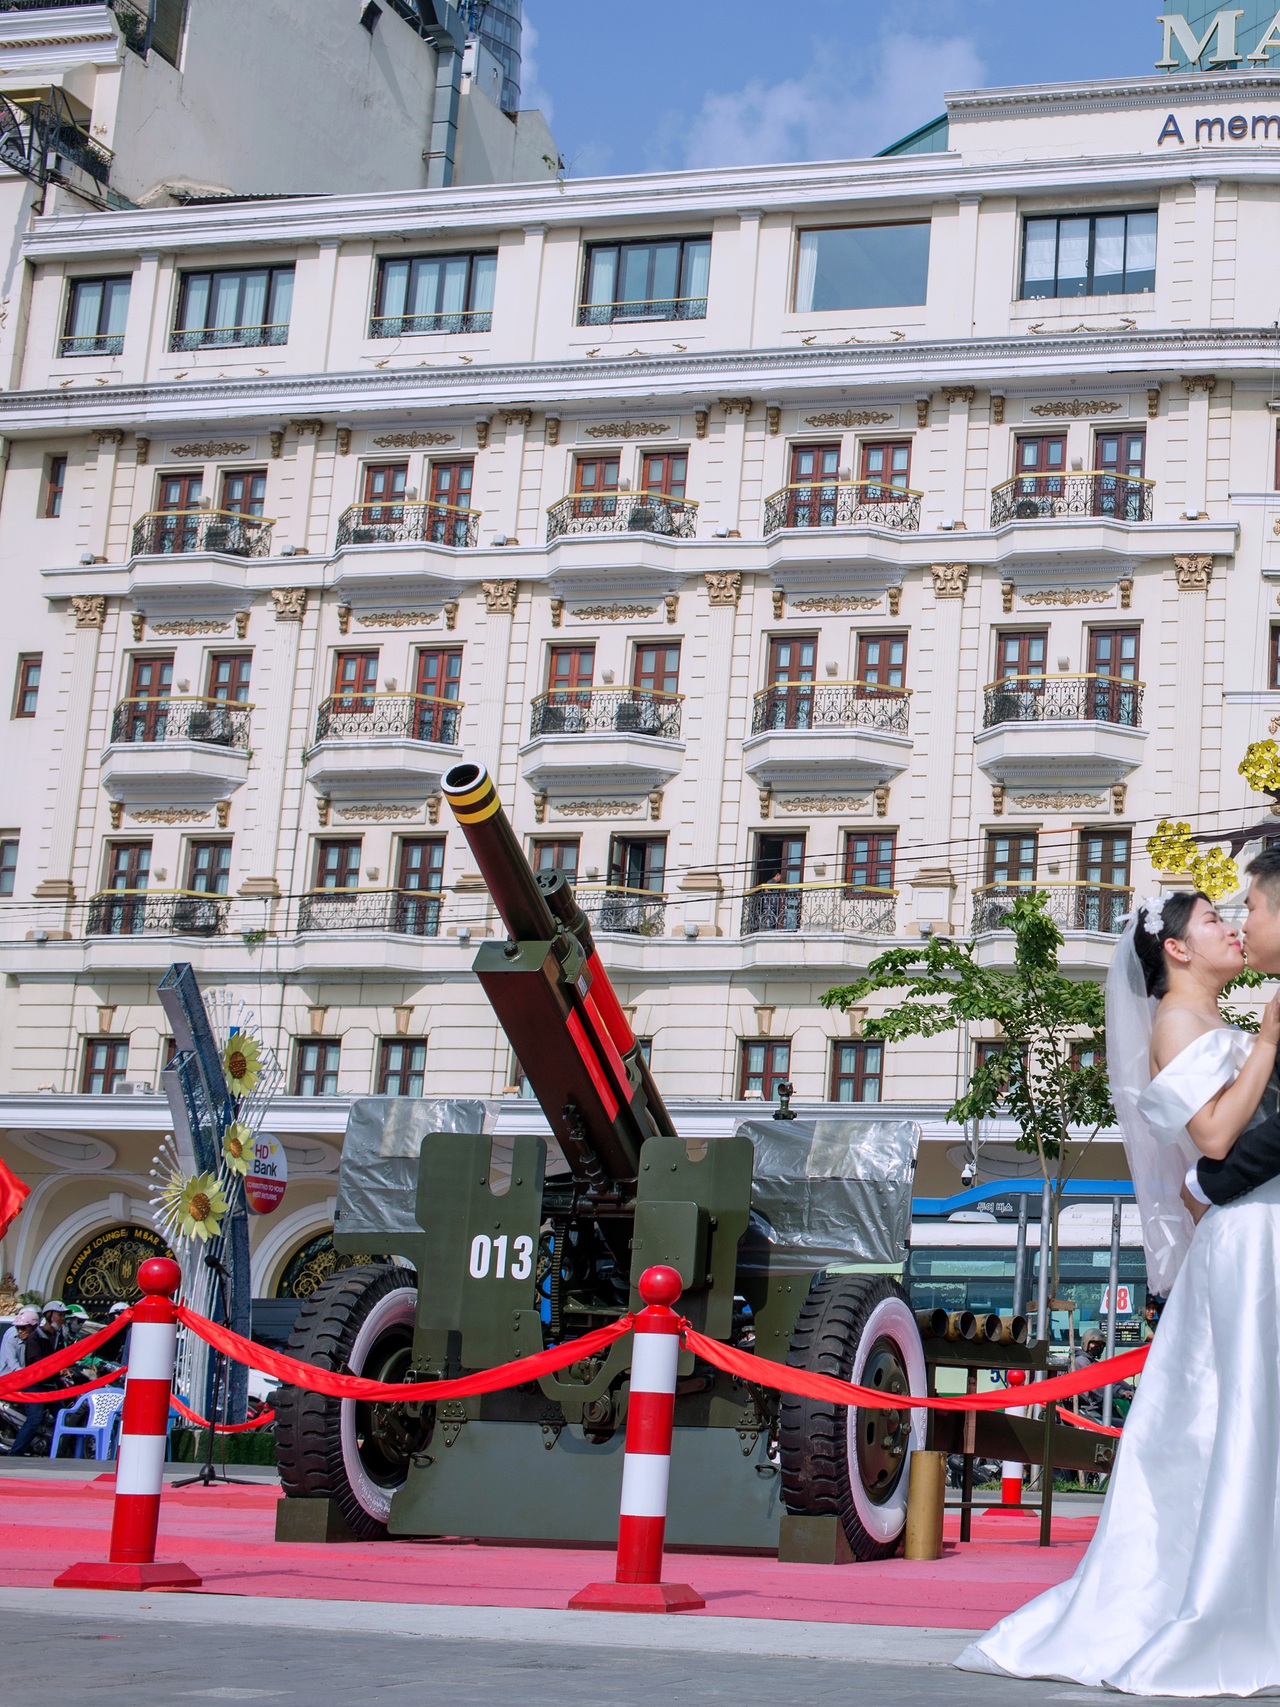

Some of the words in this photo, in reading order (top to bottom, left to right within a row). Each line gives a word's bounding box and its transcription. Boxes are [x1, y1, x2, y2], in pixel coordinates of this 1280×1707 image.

[1157, 114, 1185, 145] A
[255, 1144, 269, 1159] HD
[254, 1159, 277, 1177] Bank
[977, 1202, 994, 1213] 투어
[996, 1203, 1013, 1213] 버스
[92, 1228, 127, 1249] LOUNGE
[470, 1235, 533, 1280] 013
